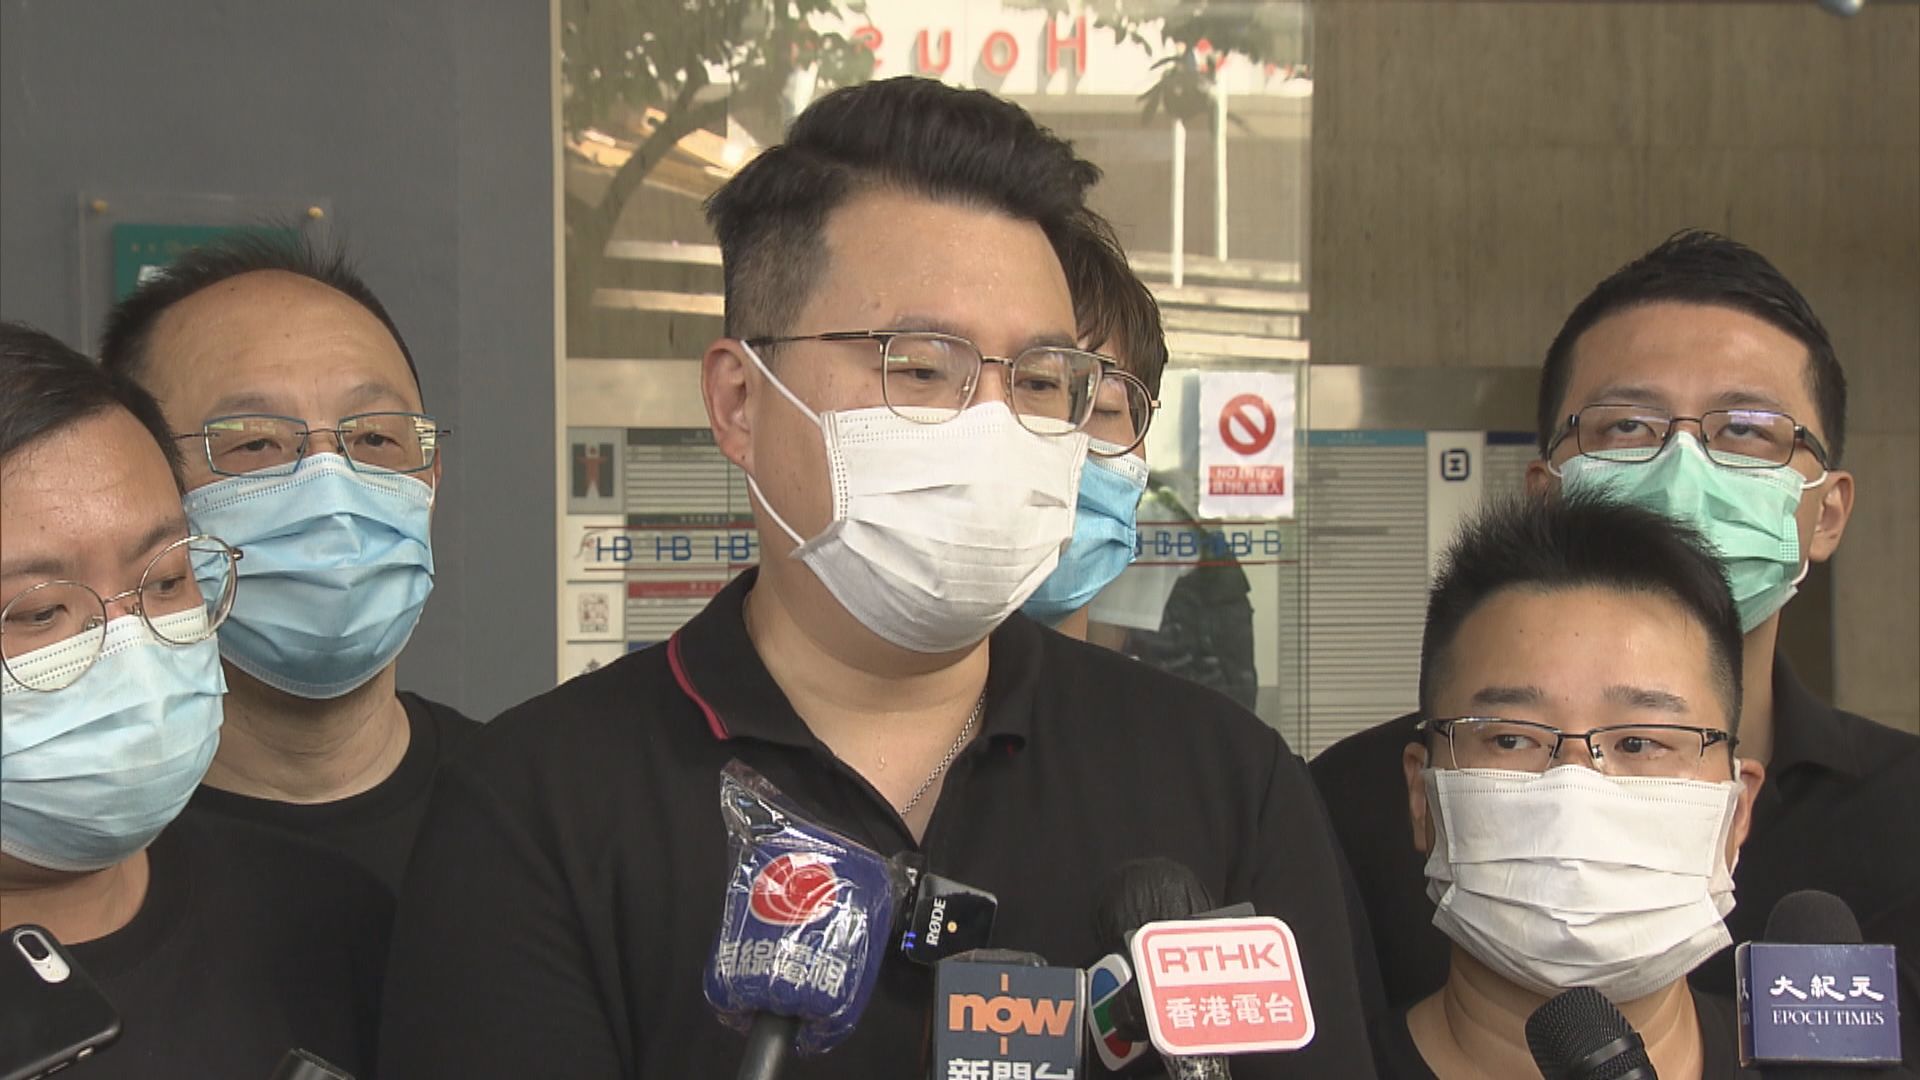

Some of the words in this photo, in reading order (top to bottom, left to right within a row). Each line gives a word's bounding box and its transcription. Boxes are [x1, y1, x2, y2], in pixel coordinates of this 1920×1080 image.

[1157, 943, 1280, 974] RTHK
[1770, 974, 1885, 1002] 大紀元
[948, 993, 1075, 1037] now
[1166, 993, 1296, 1030] 香港電台
[1773, 1010, 1829, 1026] EPOCH
[1833, 1010, 1885, 1026] TIMES
